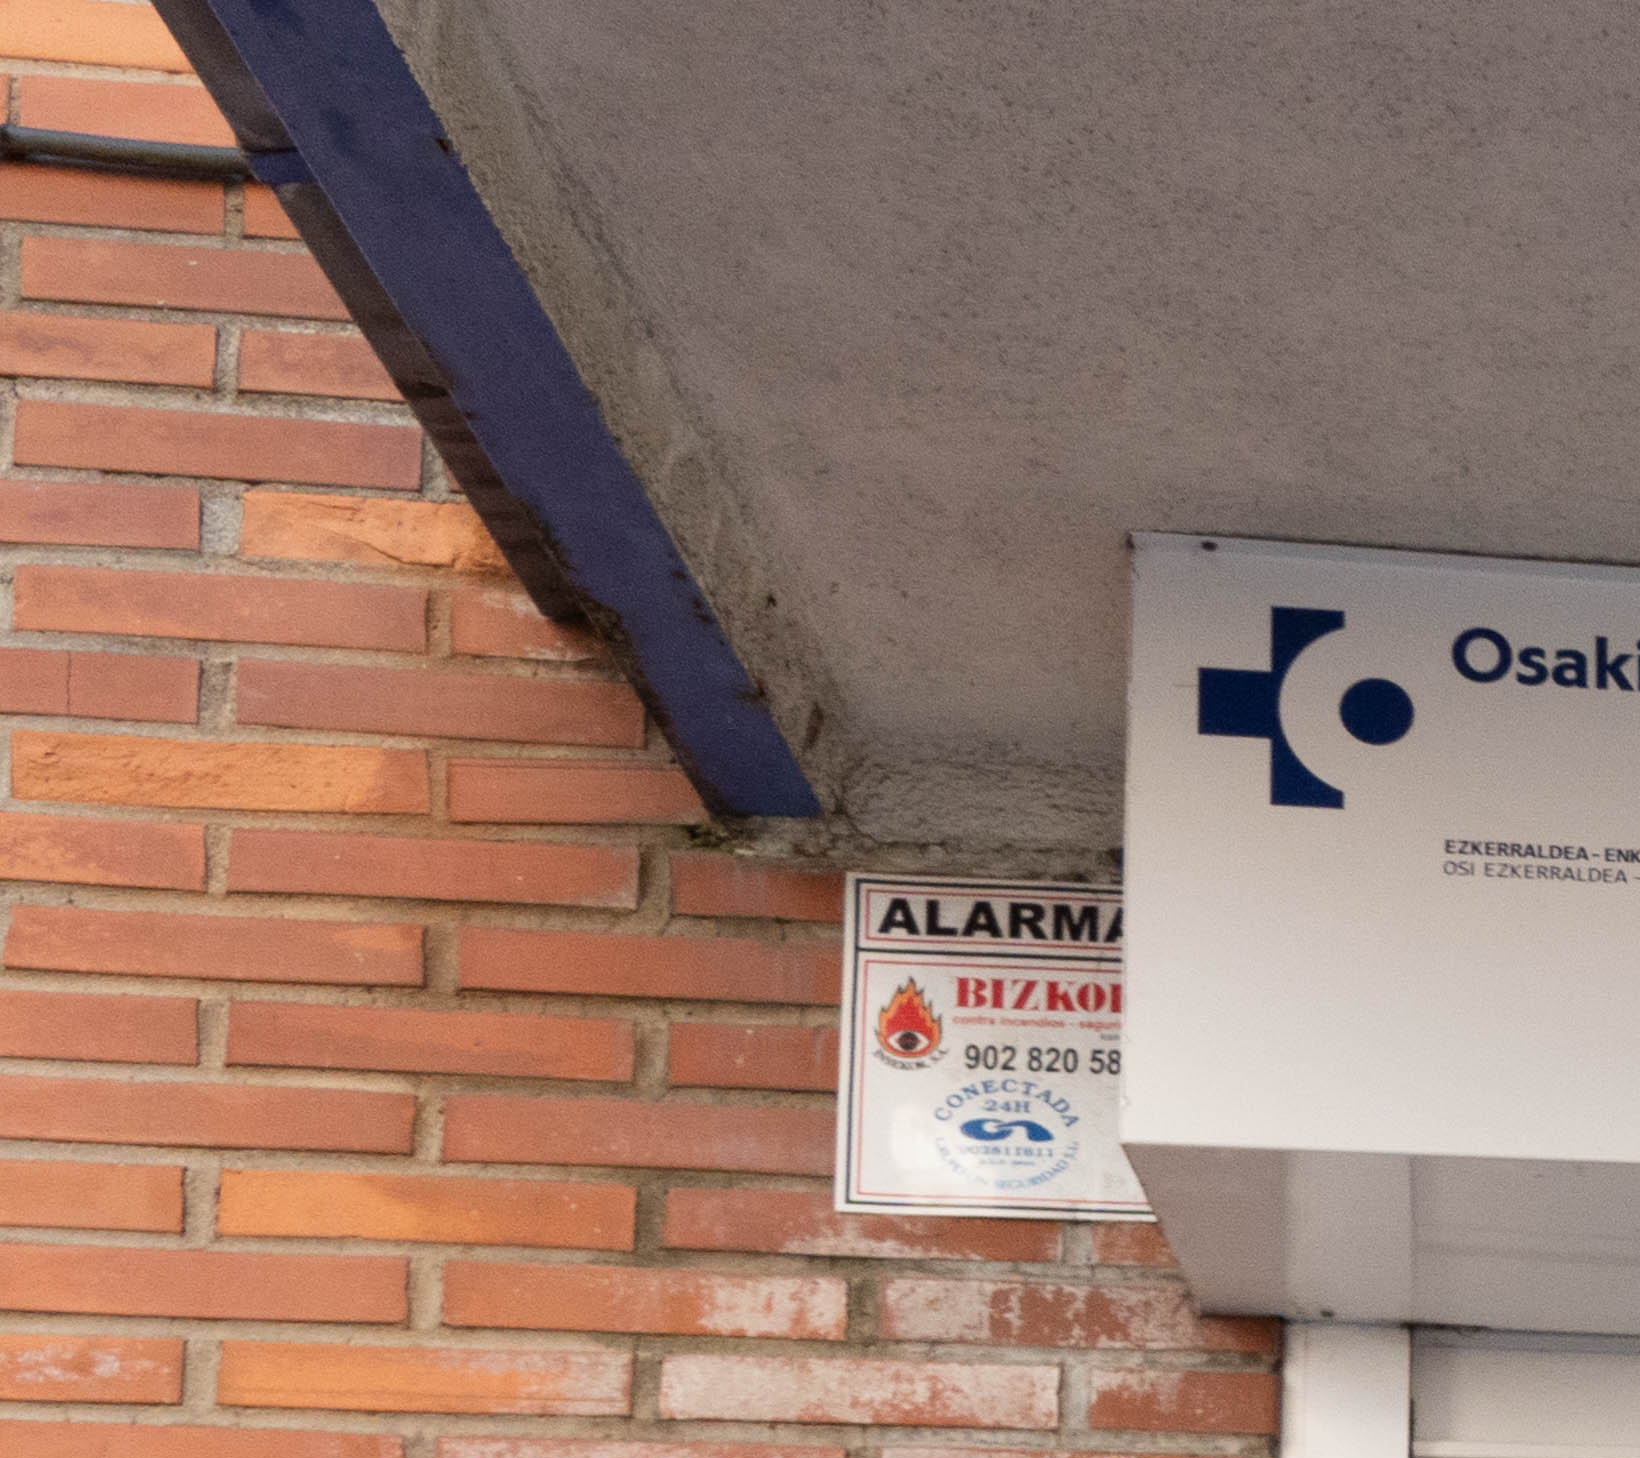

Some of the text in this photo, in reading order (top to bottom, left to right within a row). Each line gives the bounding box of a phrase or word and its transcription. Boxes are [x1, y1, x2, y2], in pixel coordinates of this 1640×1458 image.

[1444, 839, 1589, 862] EZKERRALDEA
[1443, 860, 1476, 876] OSI
[1484, 862, 1628, 885] EZKERRALDEA
[964, 1045, 1017, 1071] 902
[1027, 1047, 1079, 1074] 820
[934, 1078, 1080, 1128] CONECTADA
[982, 1099, 1031, 1114] 24H
